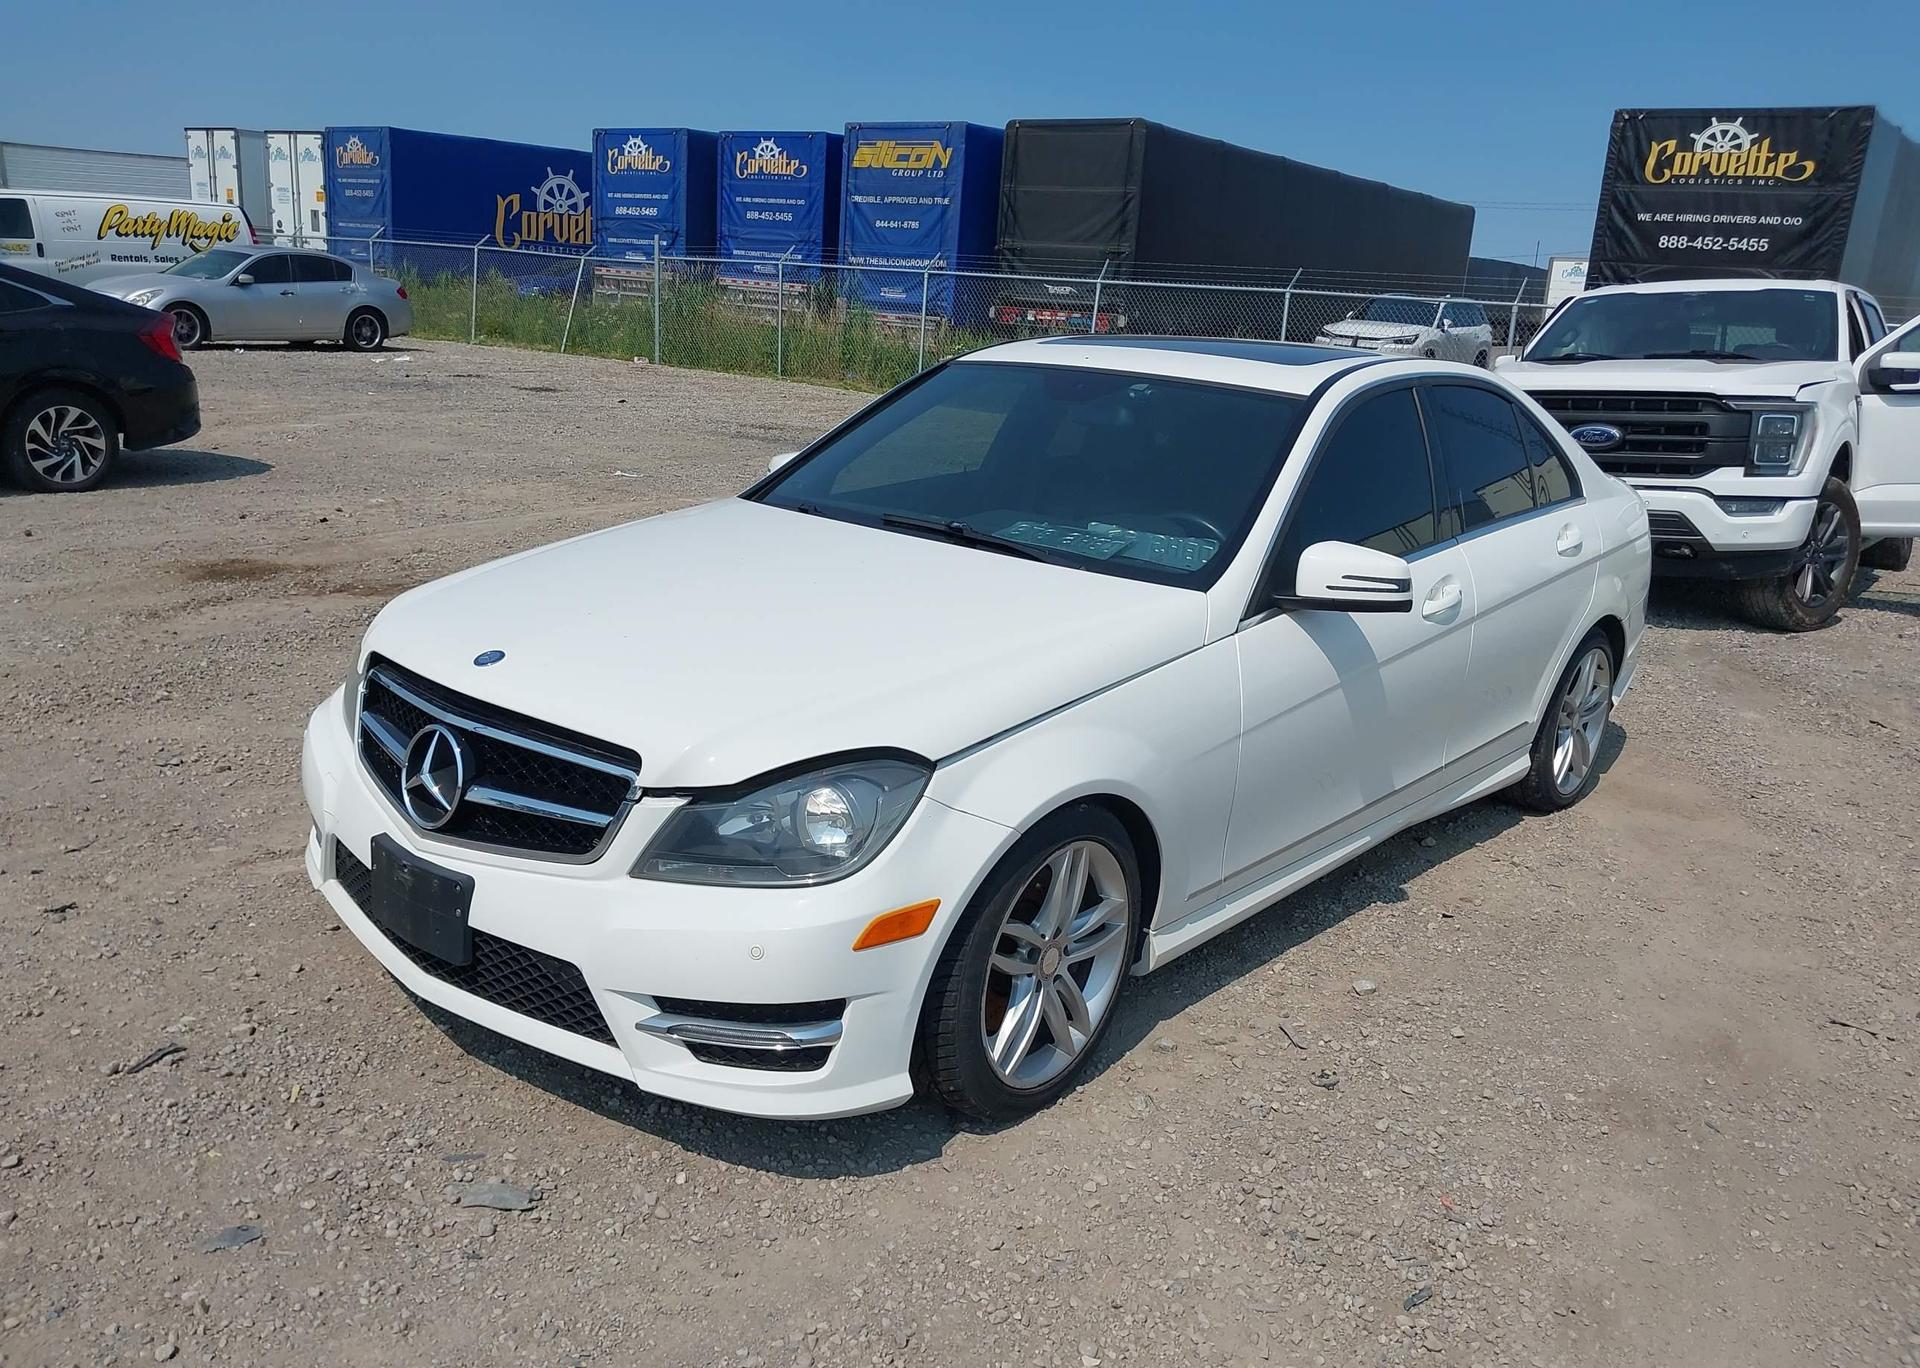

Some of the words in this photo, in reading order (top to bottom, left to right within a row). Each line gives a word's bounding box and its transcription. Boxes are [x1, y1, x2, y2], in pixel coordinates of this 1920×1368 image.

[336, 145, 379, 168] Corvette
[608, 147, 670, 174] Corvette
[1644, 137, 1815, 185] Corvette
[736, 150, 807, 179] Corvette
[891, 169, 923, 177] GROUP
[850, 195, 883, 204] CREDIBLE,
[615, 206, 658, 216] 888-452-5455
[746, 210, 793, 221] 888-452-5455
[496, 194, 592, 250] Corvet
[875, 220, 920, 229] 844-641-8785
[1637, 213, 1652, 222] WE
[1654, 213, 1674, 222] ARE
[1676, 214, 1710, 223] HIRING
[1712, 215, 1757, 224] DRIVERS
[1758, 216, 1781, 225] AND
[1658, 236, 1769, 251] 888-452-5455
[111, 254, 151, 264] Rentals,
[1580, 431, 1608, 441] Ford
